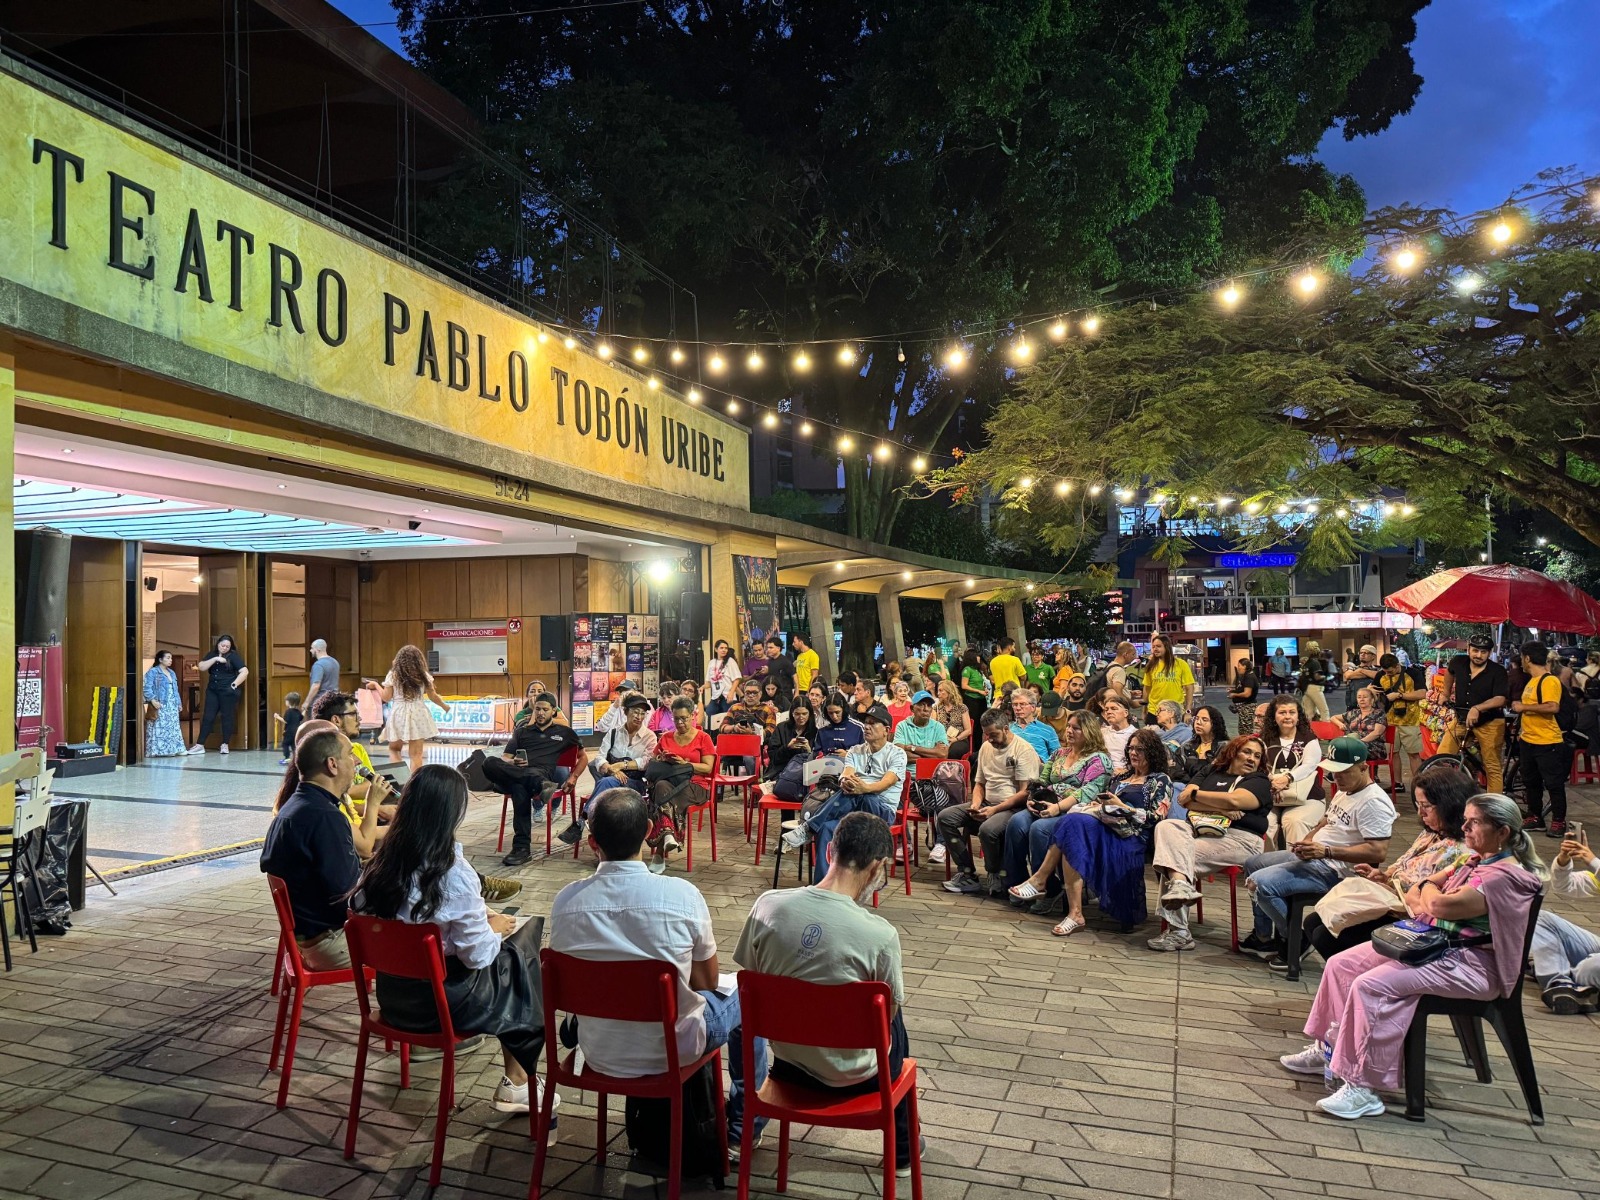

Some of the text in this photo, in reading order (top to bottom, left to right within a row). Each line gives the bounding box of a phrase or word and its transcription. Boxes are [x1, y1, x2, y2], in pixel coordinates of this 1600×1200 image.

[33, 138, 725, 482] TEATRO PABLO TOBÓN URIBE
[495, 475, 529, 501] 51-24
[1127, 623, 1178, 633] GIMNSIO
